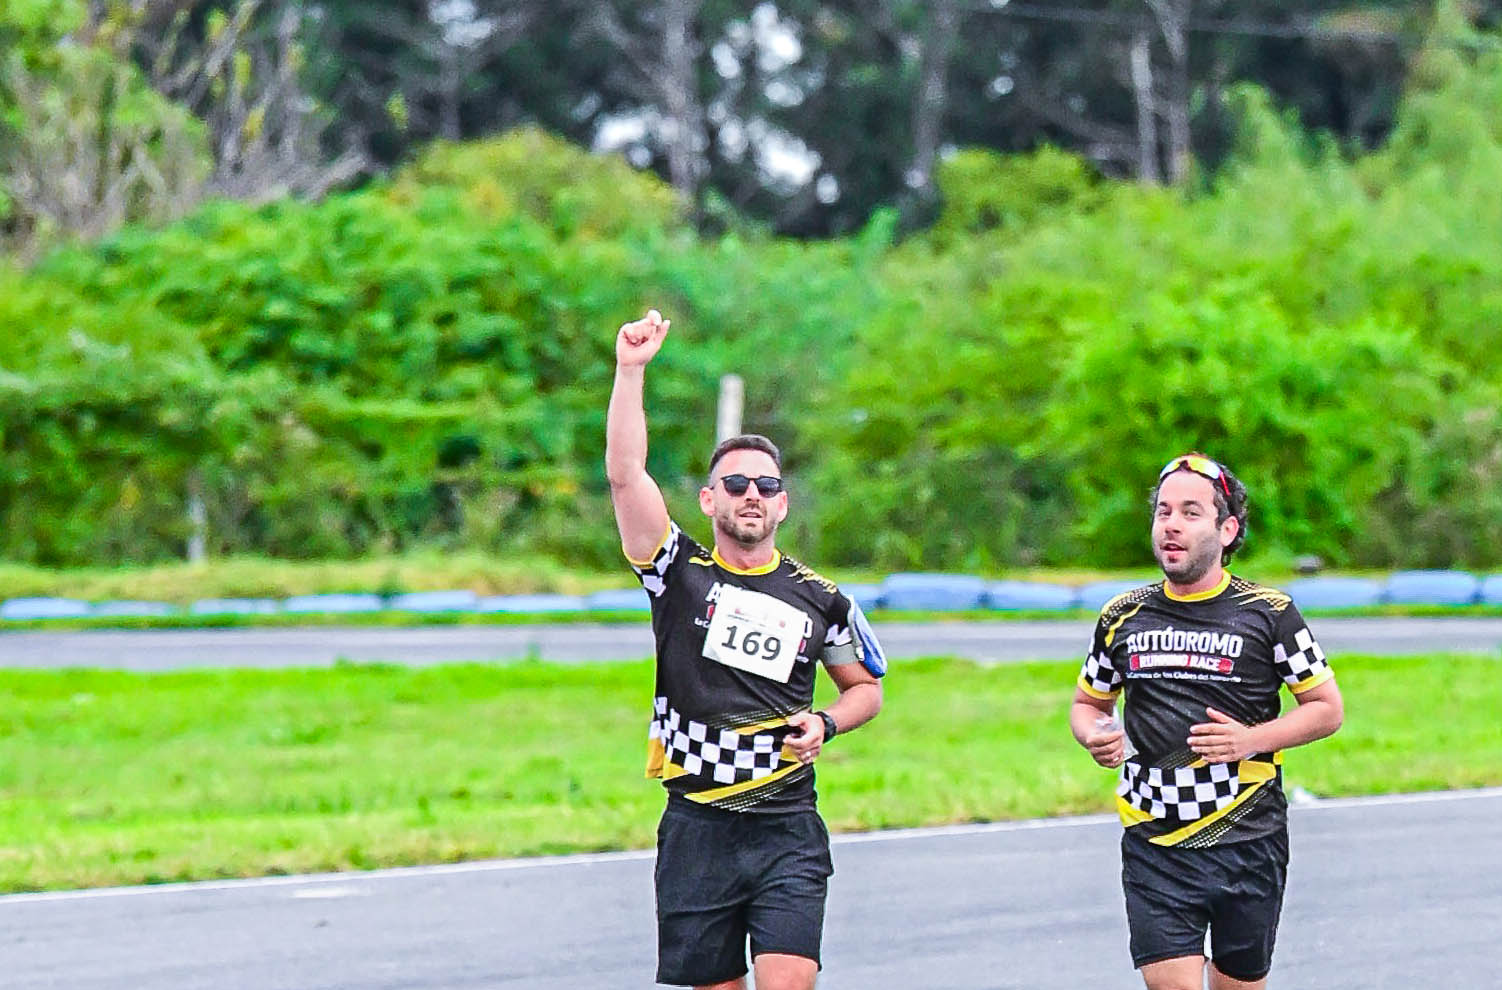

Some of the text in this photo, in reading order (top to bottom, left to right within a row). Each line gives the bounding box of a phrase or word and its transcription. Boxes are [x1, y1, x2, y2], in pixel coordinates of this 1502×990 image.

[721, 625, 781, 661] 169
[1126, 625, 1243, 658] AUTÓDROMO
[1189, 654, 1221, 672] RACE
